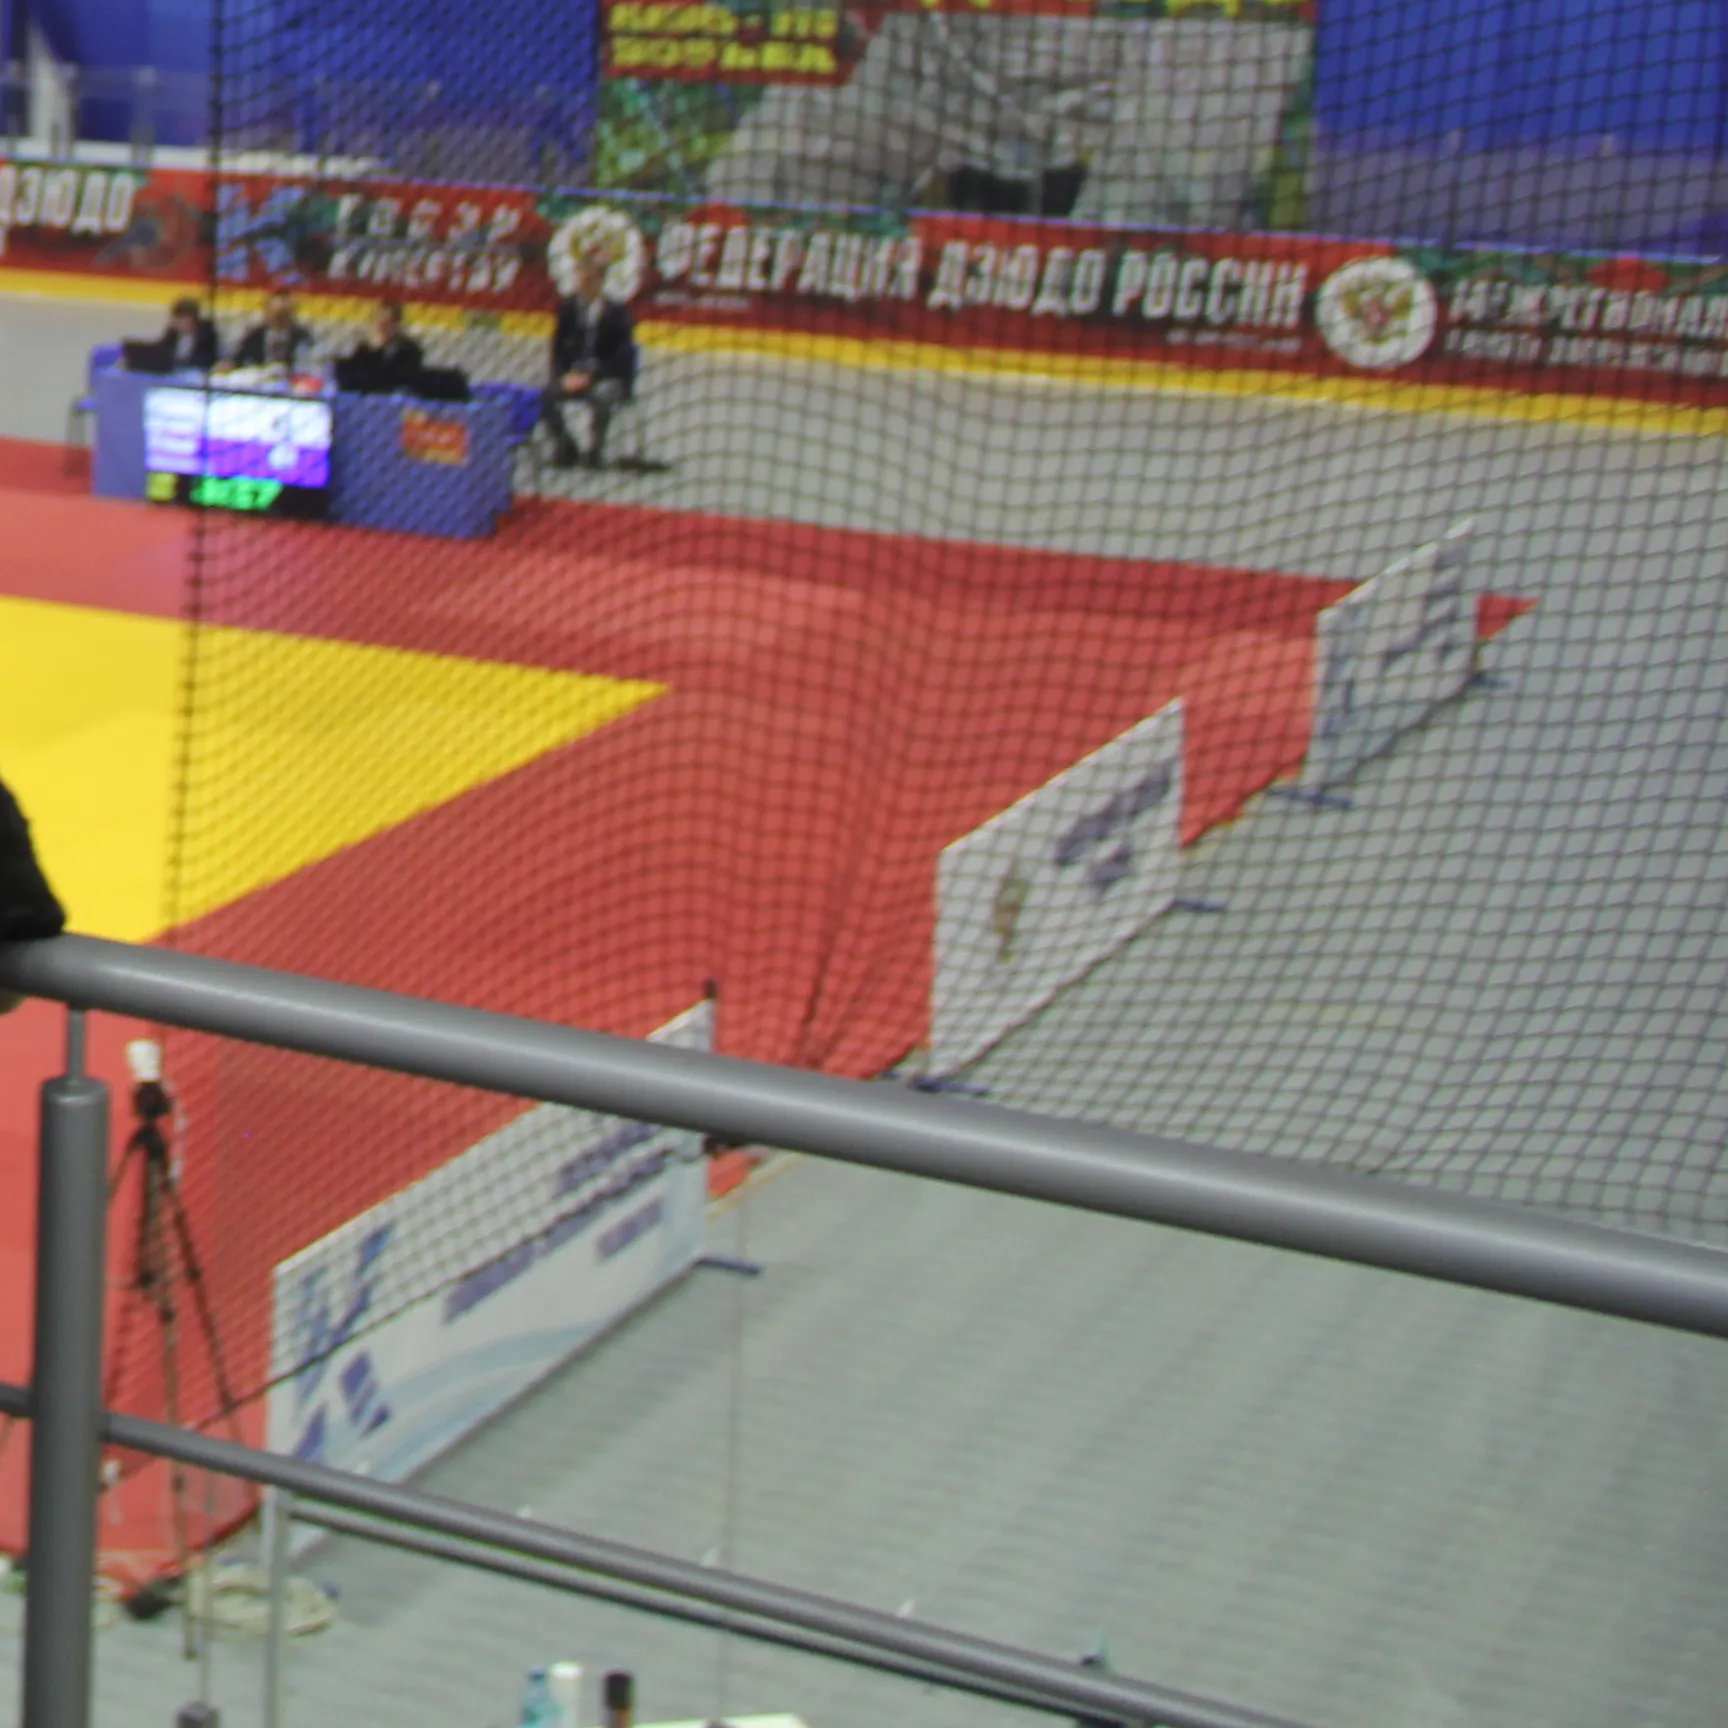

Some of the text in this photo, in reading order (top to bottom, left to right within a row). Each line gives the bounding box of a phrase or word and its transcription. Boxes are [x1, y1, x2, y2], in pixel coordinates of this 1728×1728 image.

[655, 220, 1308, 329] ФЕДЕРАЦИЯ ДЗЮДО РОССИИ
